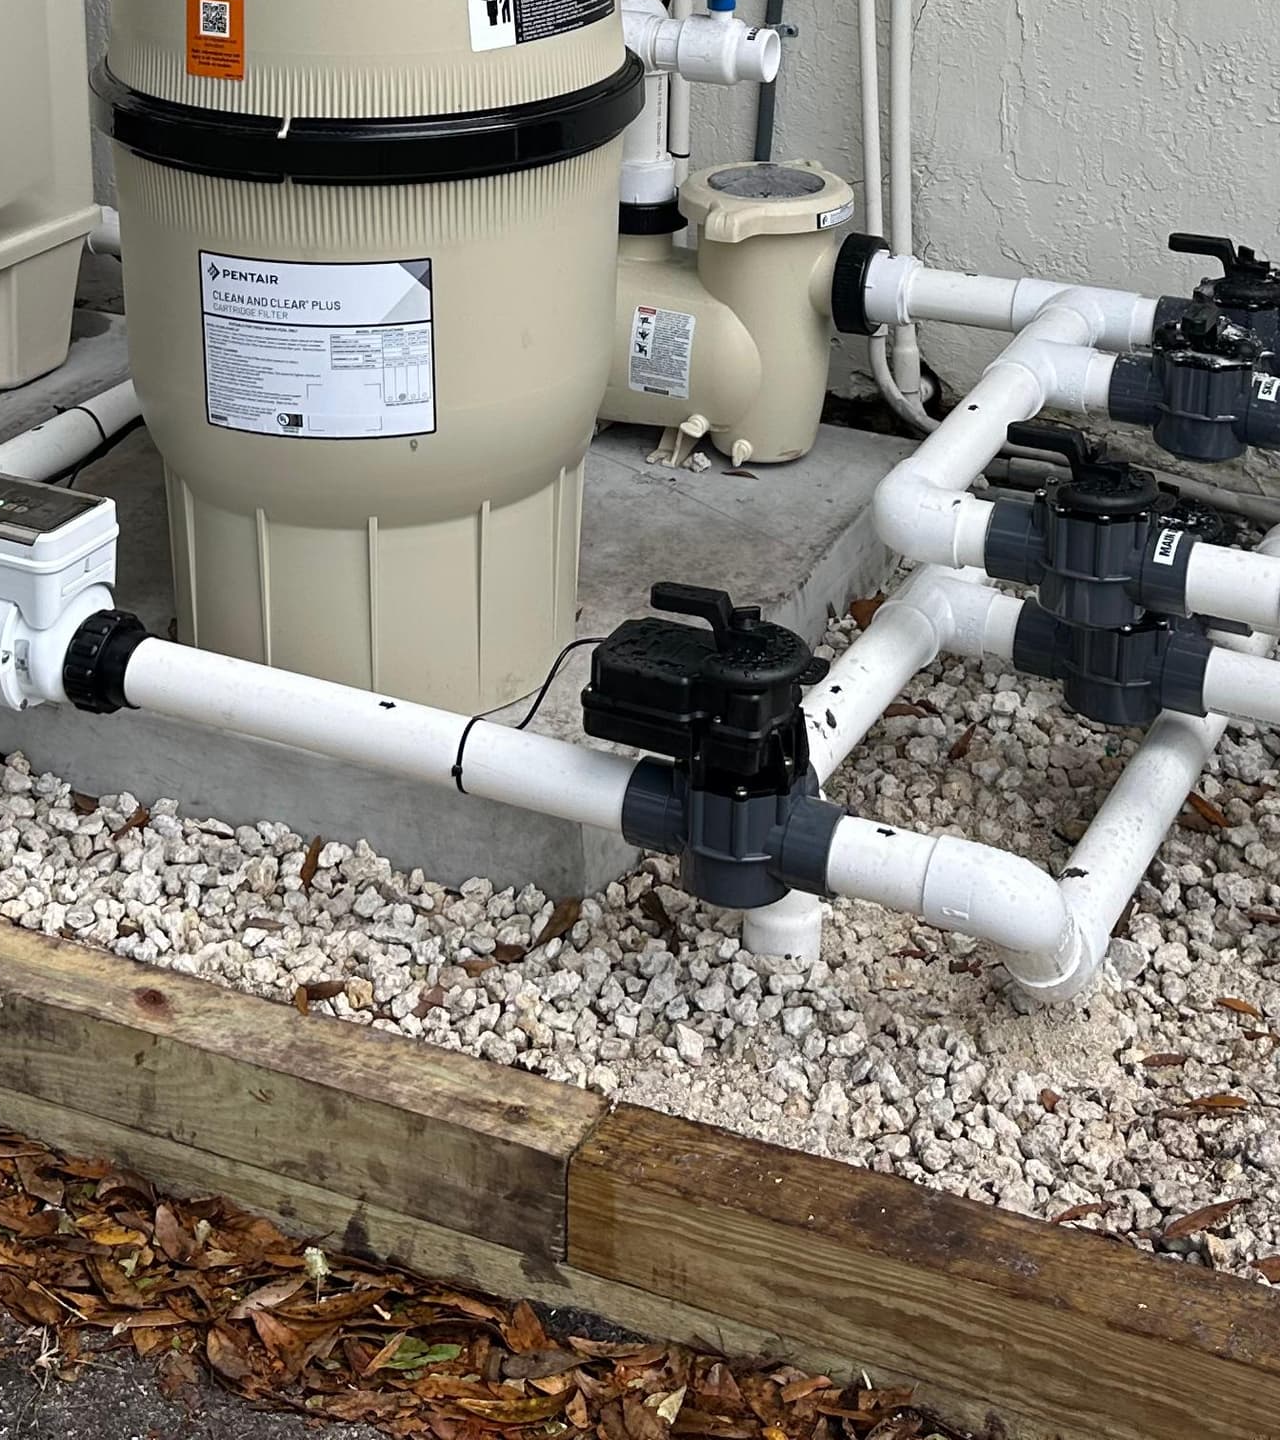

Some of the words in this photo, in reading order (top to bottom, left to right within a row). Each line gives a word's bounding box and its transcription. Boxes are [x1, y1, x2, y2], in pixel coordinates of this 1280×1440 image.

[222, 269, 279, 285] PENTAIR
[212, 290, 245, 304] CLEAN
[247, 296, 268, 307] AND
[311, 300, 341, 311] PLUS
[213, 303, 257, 317] CARTRIDGE
[258, 310, 289, 320] FILTER
[1158, 534, 1176, 557] MAIN
